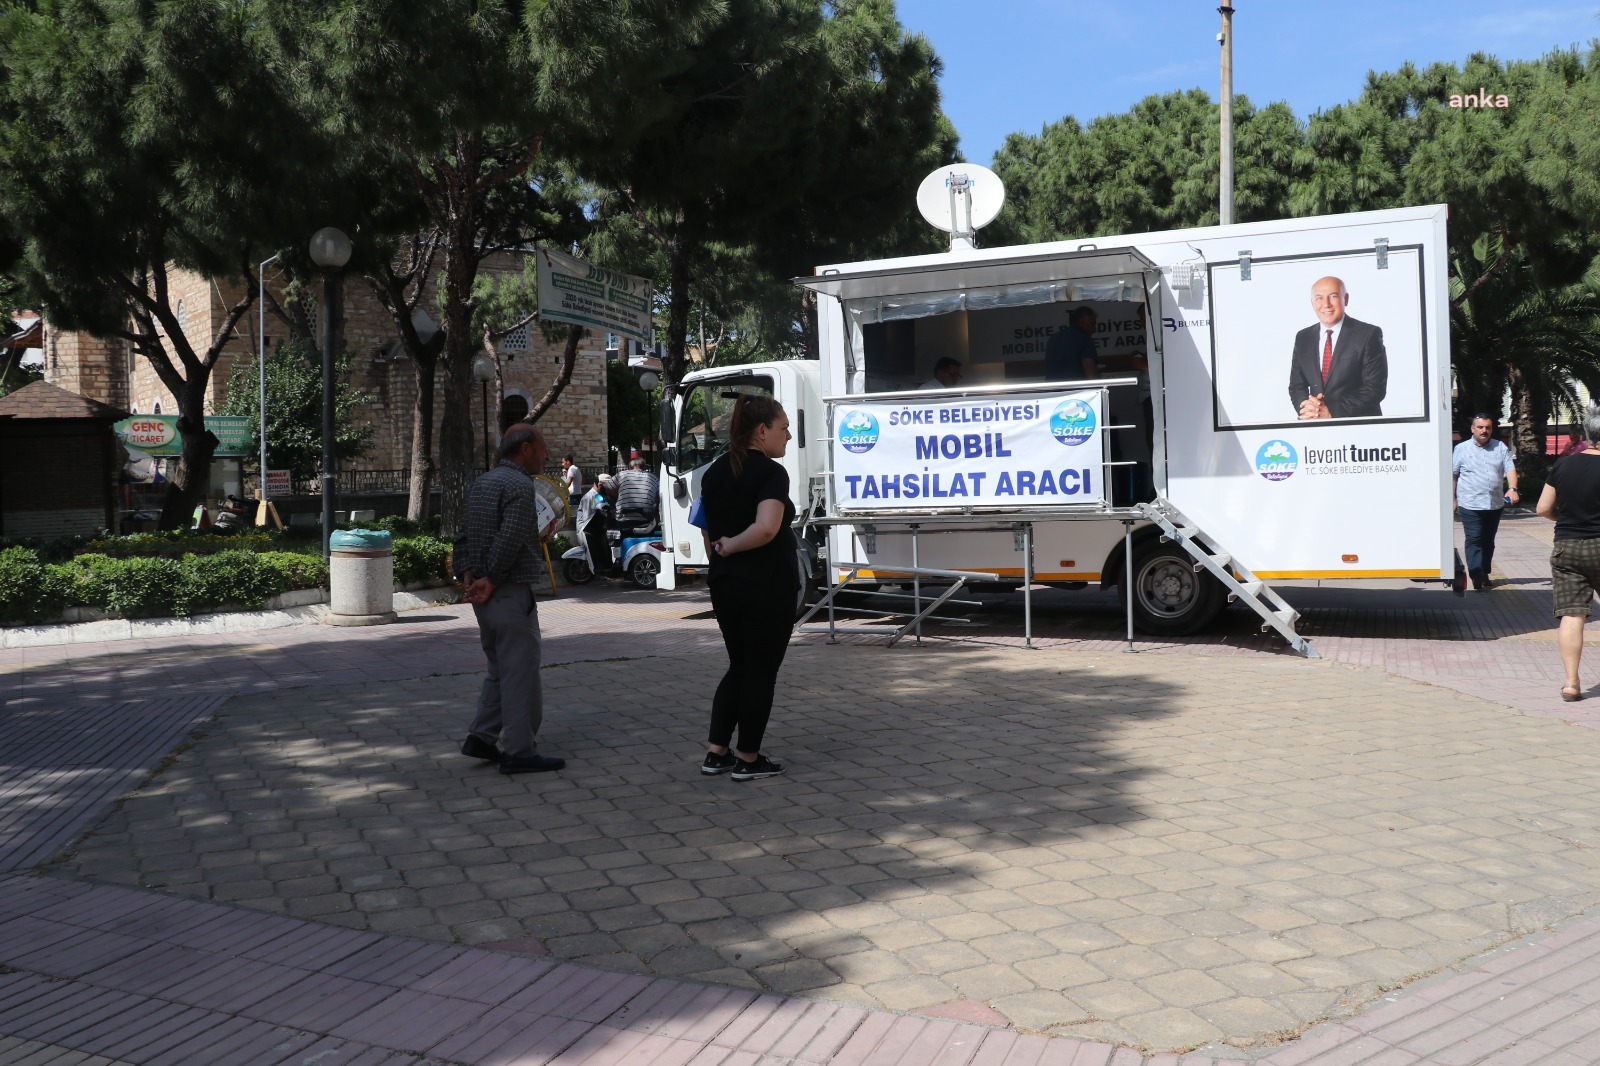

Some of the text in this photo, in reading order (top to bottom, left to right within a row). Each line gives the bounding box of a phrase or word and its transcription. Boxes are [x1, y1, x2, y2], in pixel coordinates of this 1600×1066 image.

[1014, 325, 1054, 339] SÖKE
[1002, 340, 1047, 355] MOBİL
[889, 400, 1040, 426] SÖKE BELEDİYESİ
[132, 421, 165, 434] GENÇ
[1052, 424, 1093, 437] SÖKE
[841, 433, 877, 445] SÖKE
[915, 425, 1012, 460] MOBİL
[1304, 442, 1407, 464] levent tuncel
[1259, 461, 1297, 472] SÖKE
[1305, 464, 1407, 475] T.C. SÖKE BELEDİYE BAŞKANI
[844, 466, 1091, 499] TAHSİLAT ARACI
